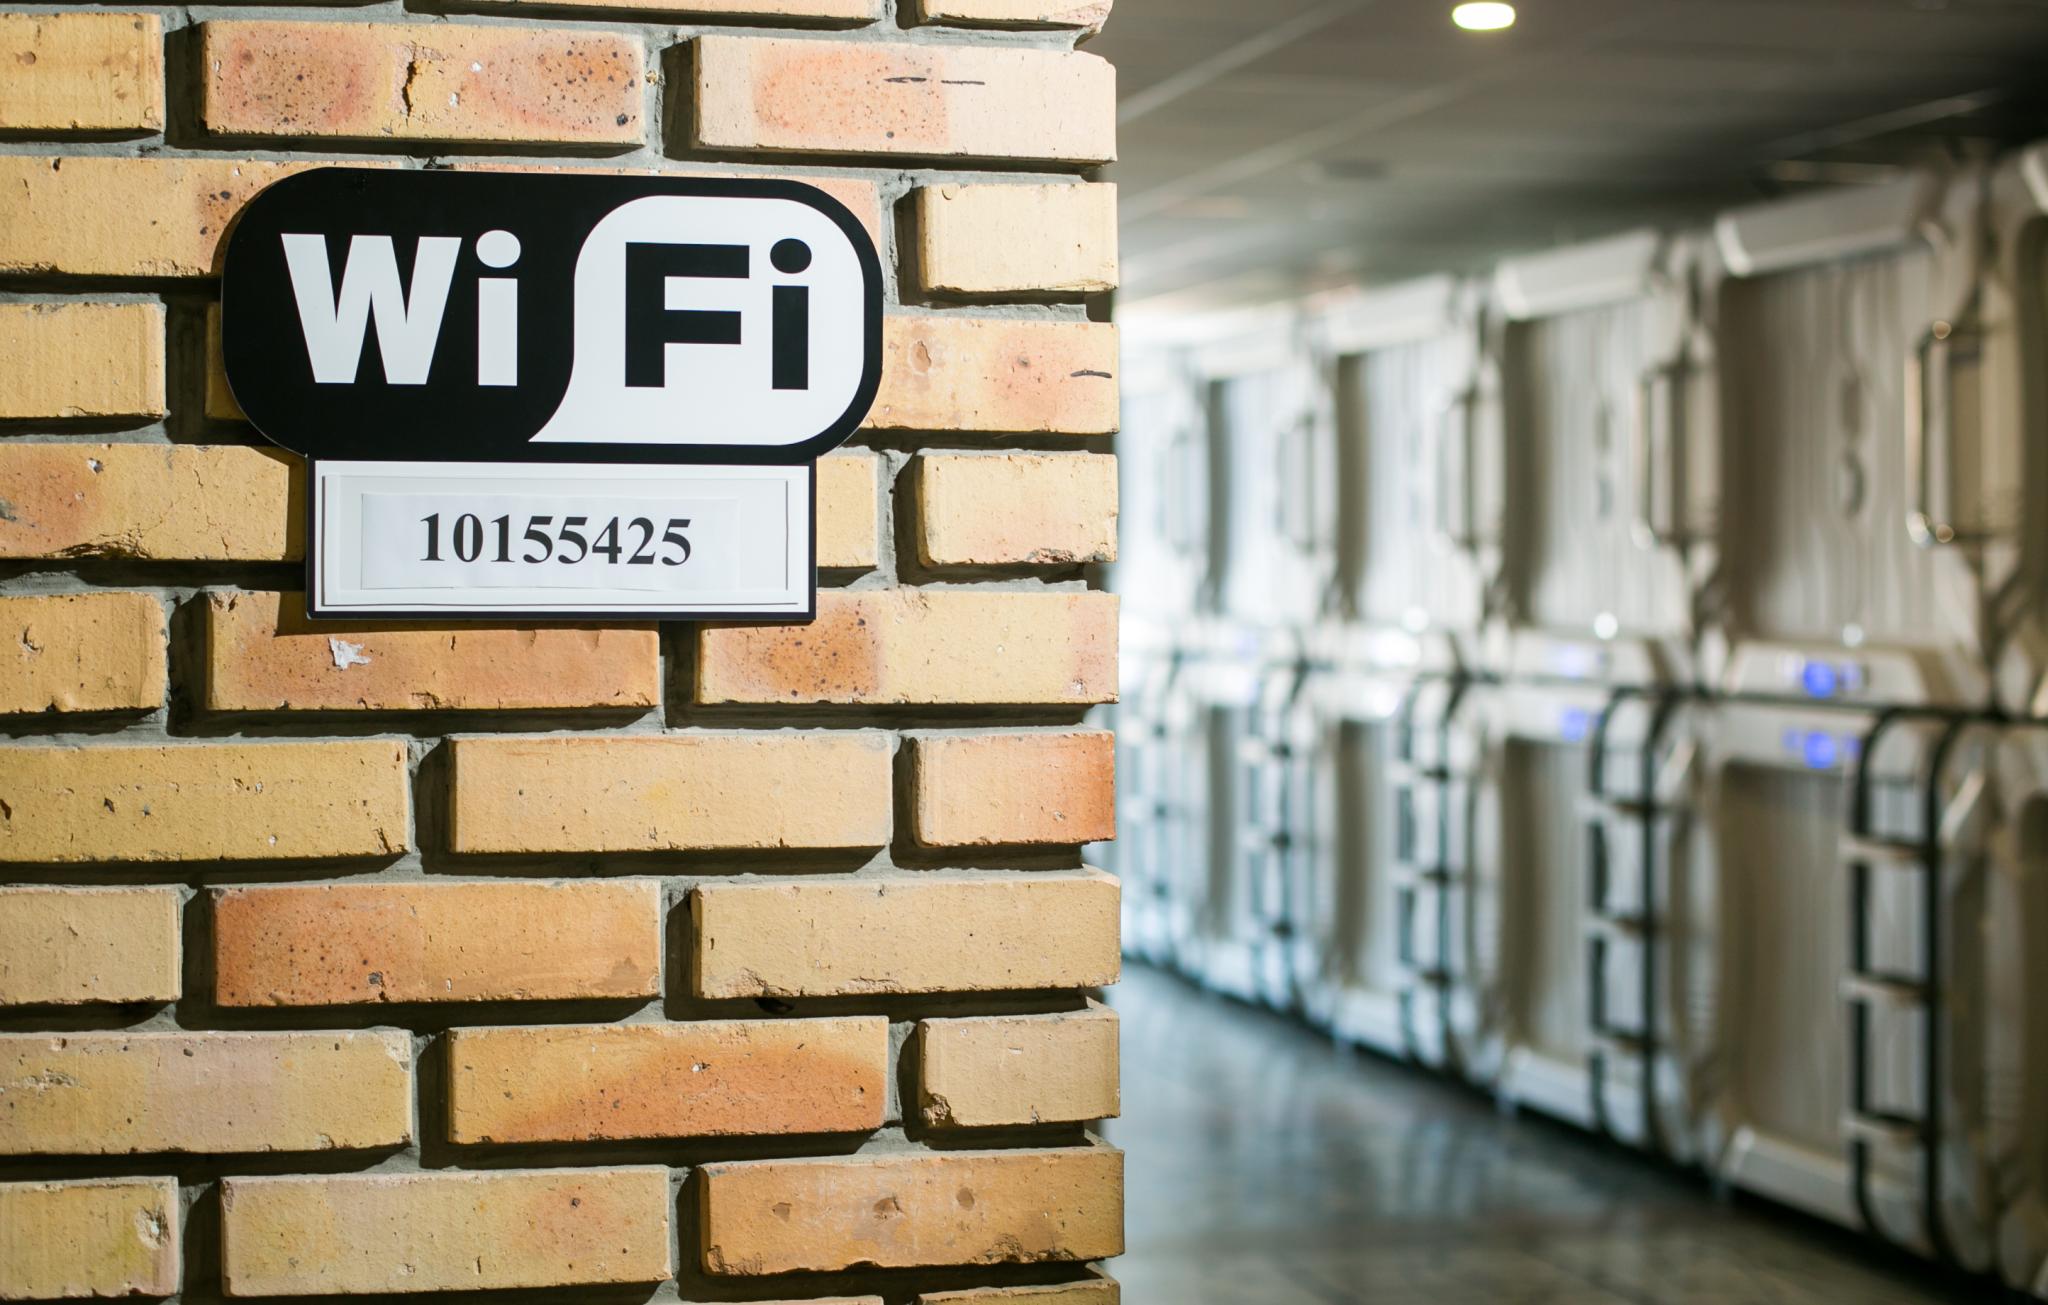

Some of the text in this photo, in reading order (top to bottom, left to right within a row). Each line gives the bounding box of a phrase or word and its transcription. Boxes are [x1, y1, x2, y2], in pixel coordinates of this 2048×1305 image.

[281, 229, 812, 391] Wi Fi
[419, 513, 692, 566] 10155425
